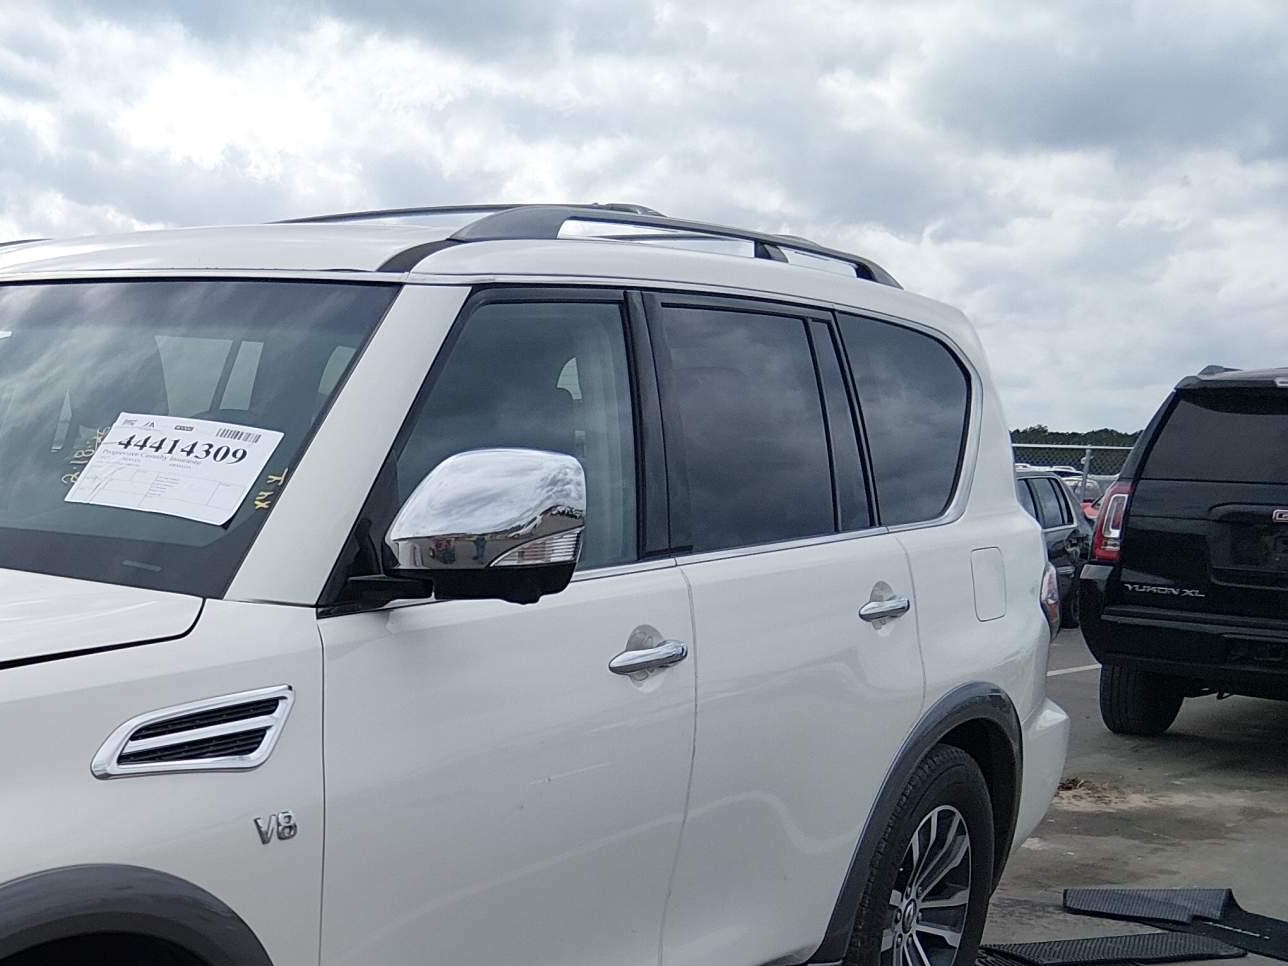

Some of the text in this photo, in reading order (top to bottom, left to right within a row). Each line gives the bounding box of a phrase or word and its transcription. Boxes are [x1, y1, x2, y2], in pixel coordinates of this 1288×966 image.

[118, 434, 249, 465] 44414309
[1123, 583, 1206, 598] YUKON XL
[253, 810, 298, 845] V8
